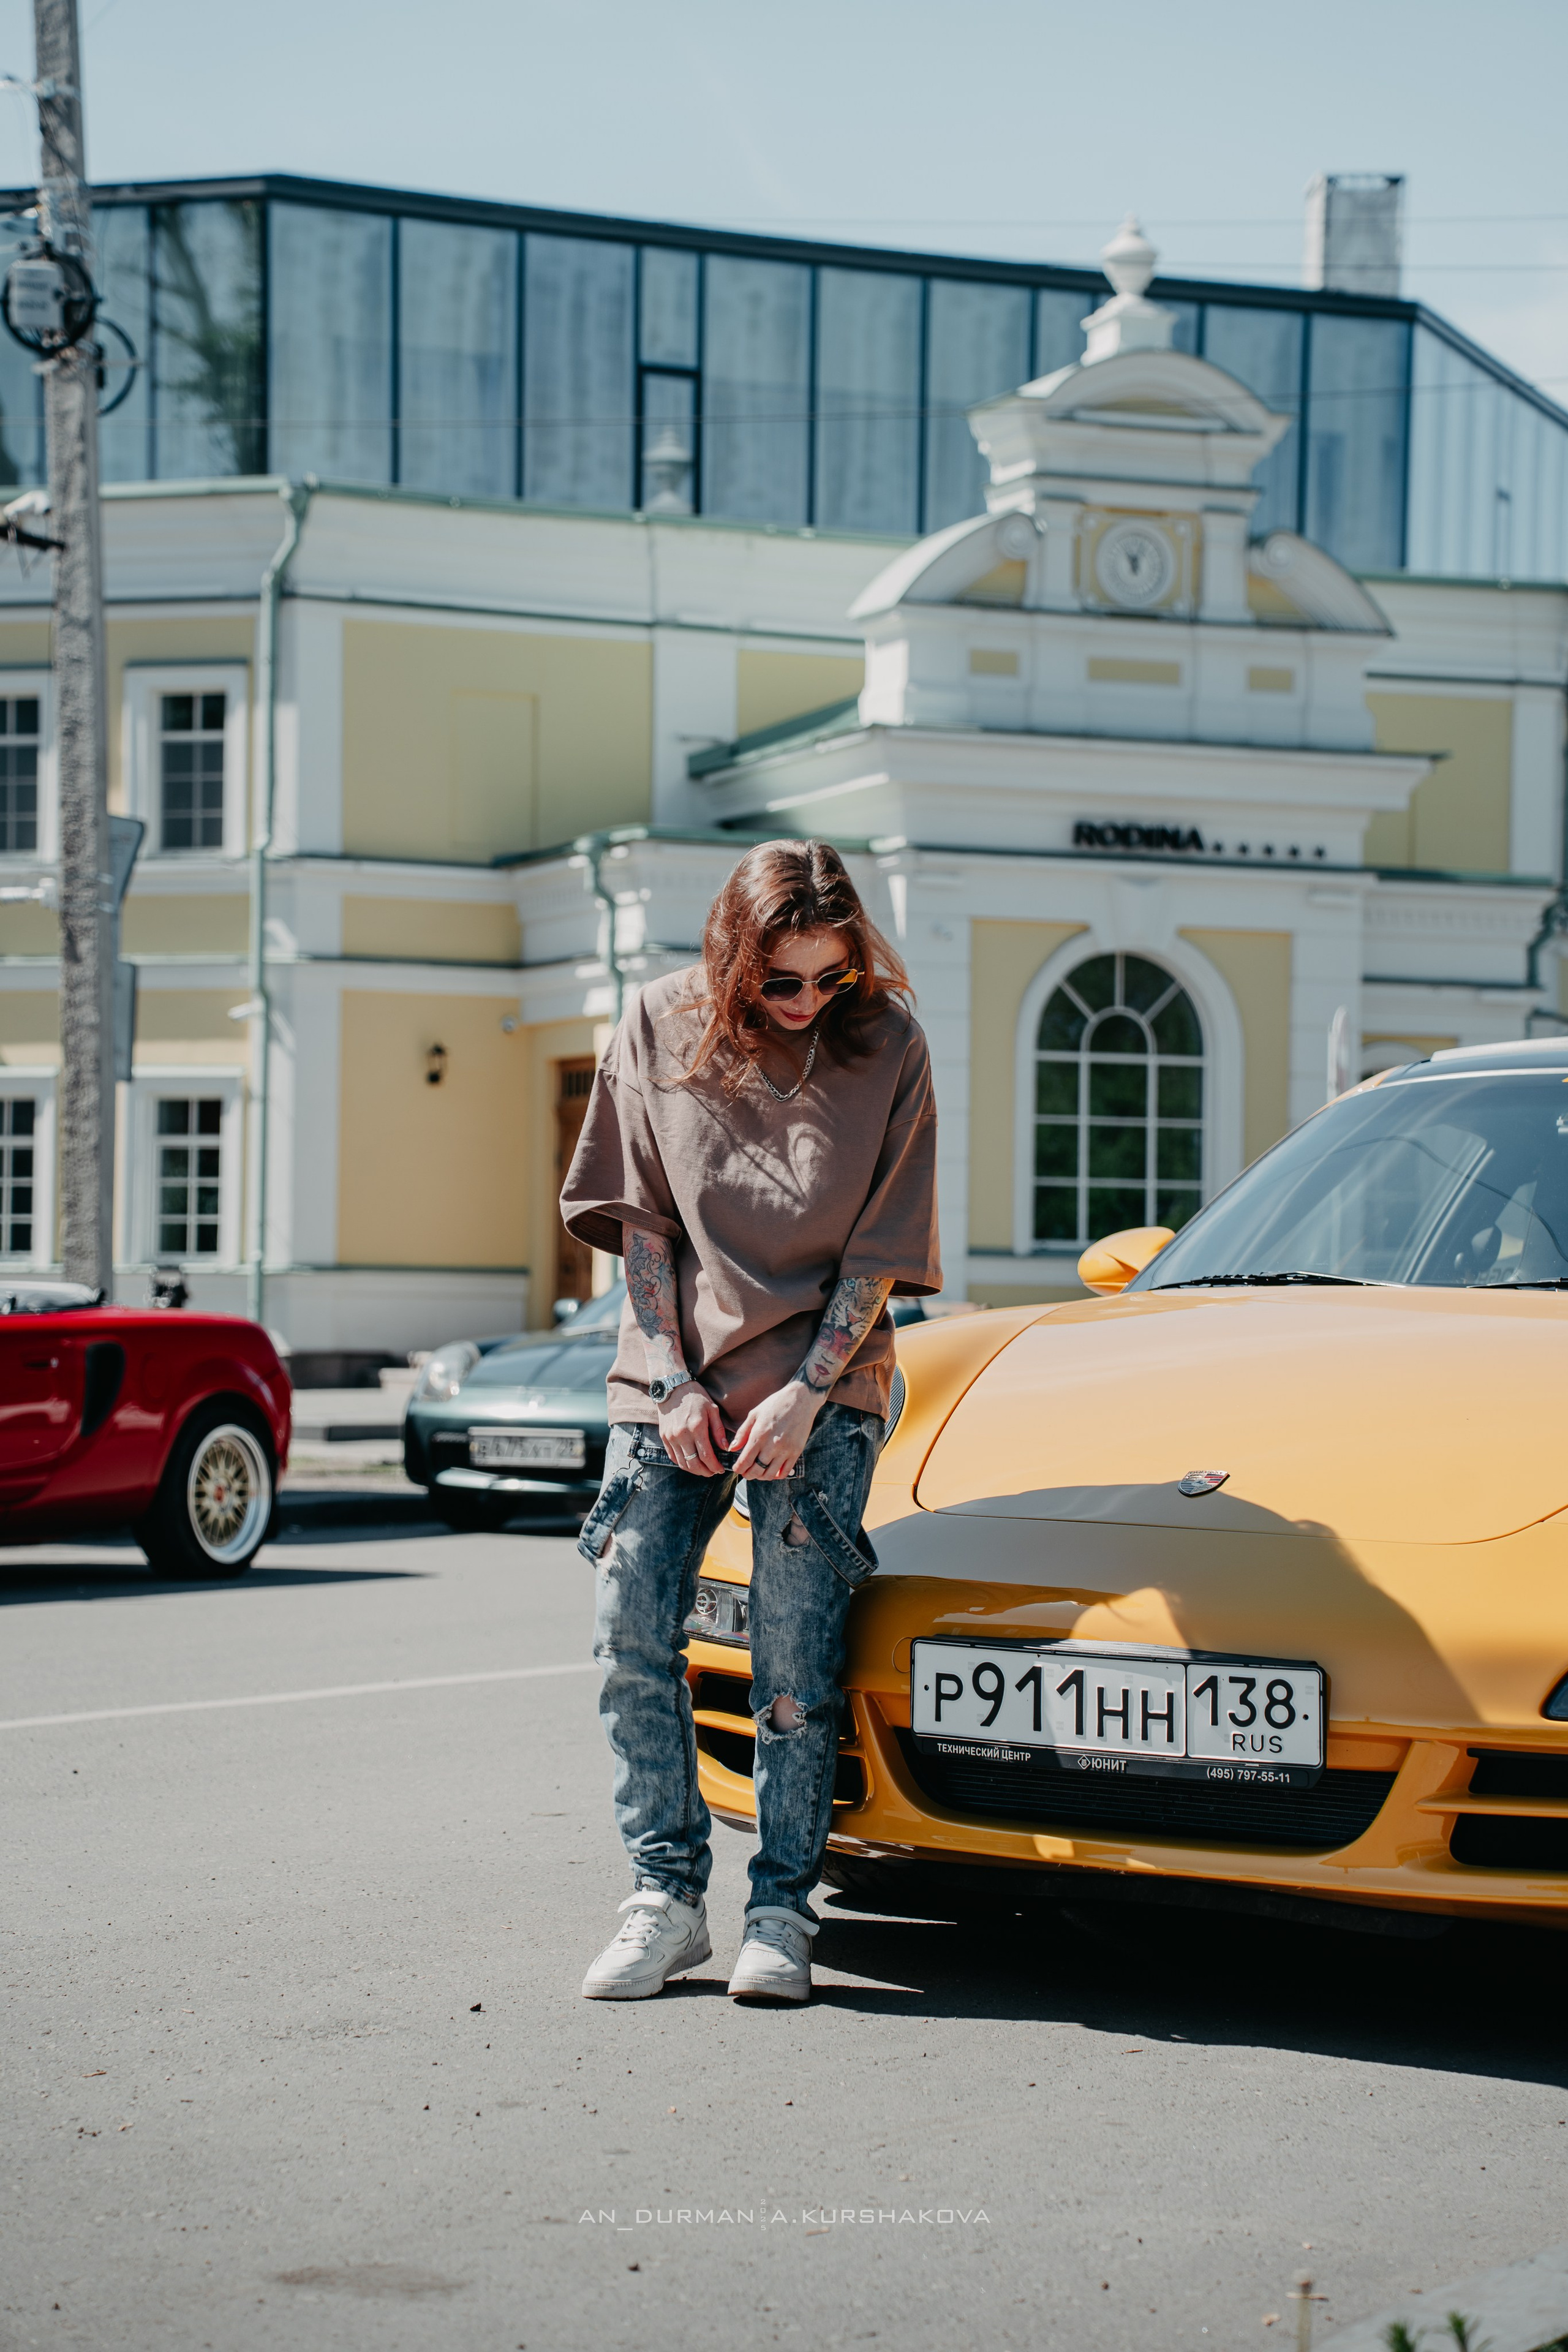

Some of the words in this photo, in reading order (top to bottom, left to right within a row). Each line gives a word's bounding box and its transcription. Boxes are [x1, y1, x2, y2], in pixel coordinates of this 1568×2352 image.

[1073, 820, 1204, 852] RODINA
[1192, 1674, 1296, 1730] 138
[937, 1743, 1000, 1759] ТЕХНИЧЕСКИЙ
[1001, 1749, 1031, 1762] ЦЕНТР
[1231, 1732, 1283, 1754] RUS
[1091, 1757, 1127, 1771] ЮНИТ
[1206, 1766, 1234, 1781] (495)
[1237, 1770, 1290, 1783] 797-55-11
